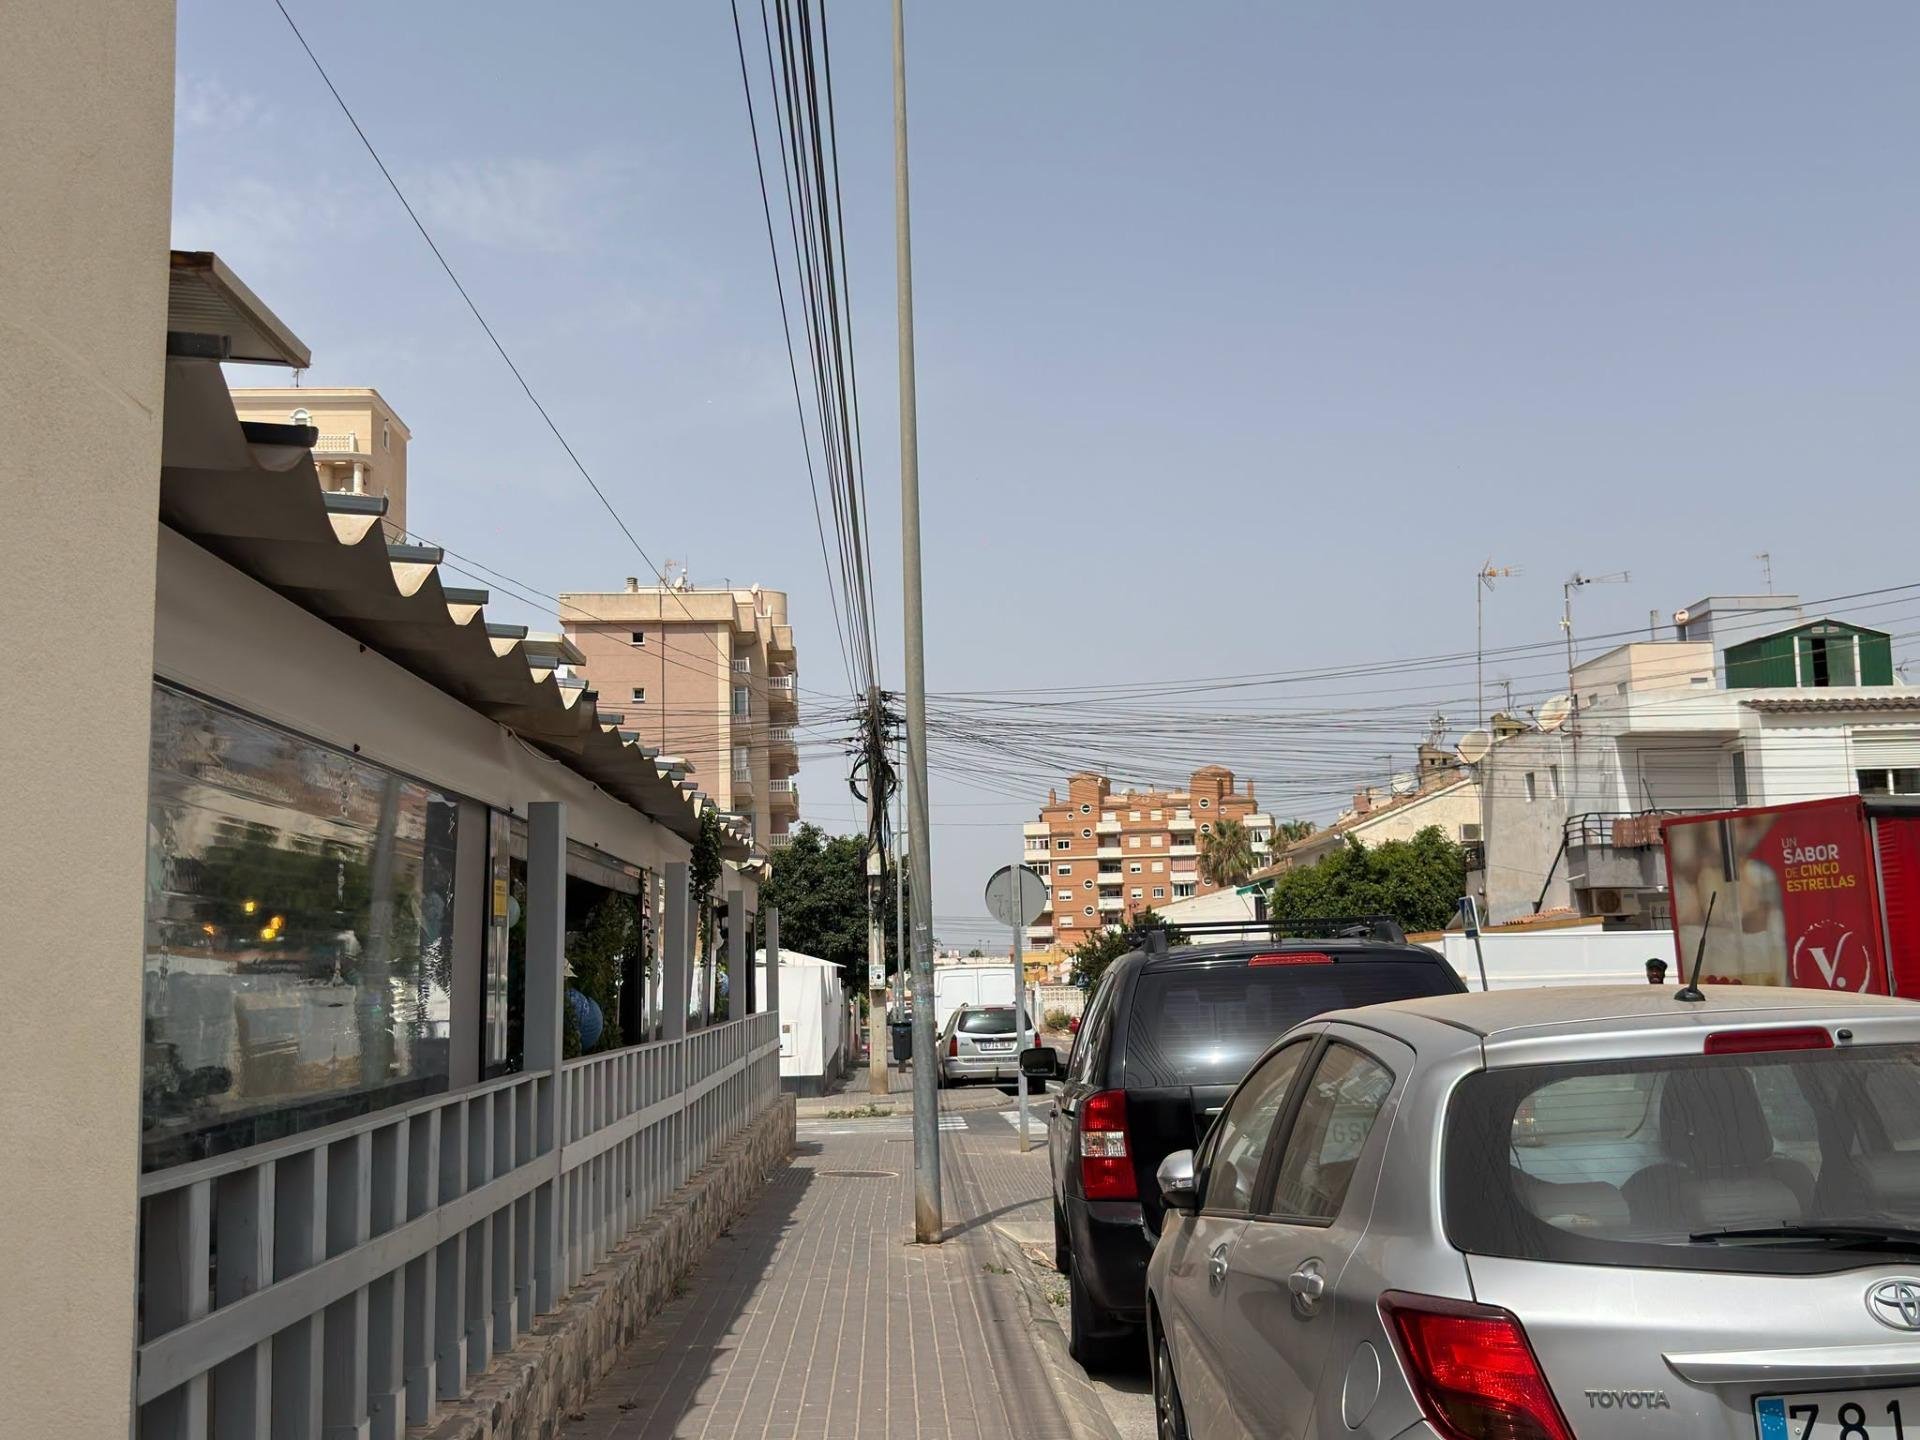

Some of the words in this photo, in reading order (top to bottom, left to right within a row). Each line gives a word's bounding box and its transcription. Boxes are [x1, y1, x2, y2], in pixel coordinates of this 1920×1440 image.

[1781, 837, 1797, 848] UN
[1783, 844, 1840, 864] SABOR
[1785, 867, 1799, 879] DE
[1801, 862, 1839, 877] CINCO
[1786, 875, 1856, 892] ESTRELLAS
[1584, 1390, 1670, 1409] TOYOTA
